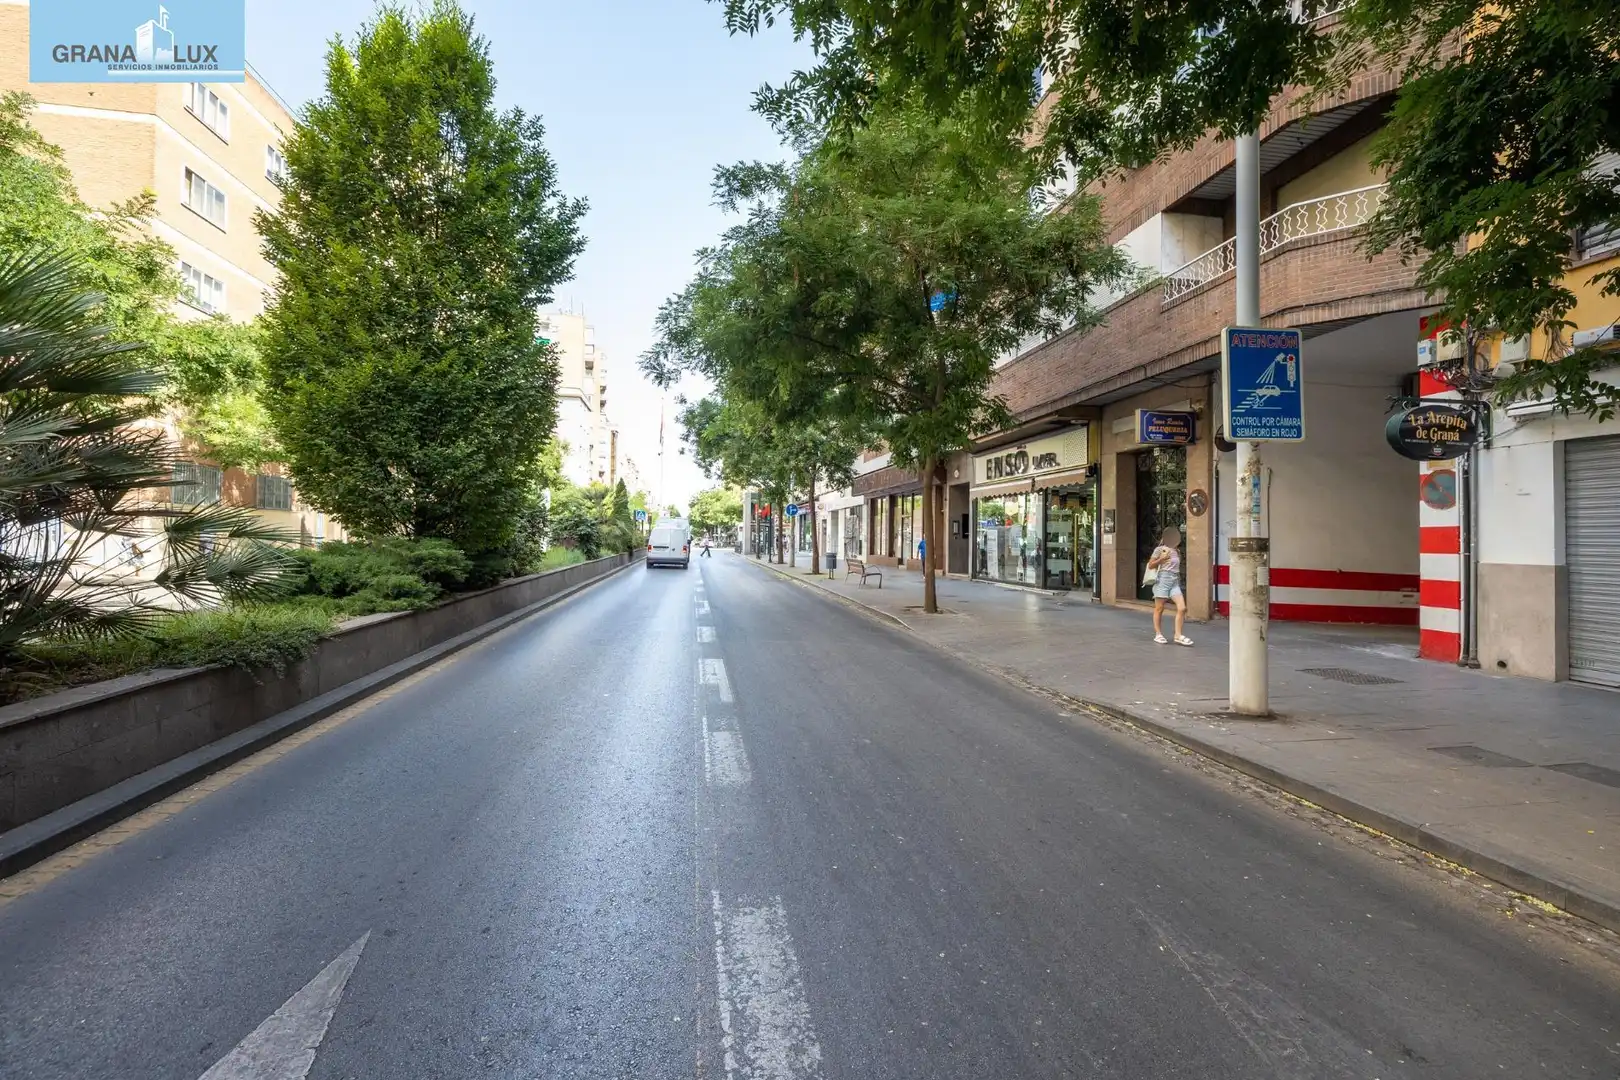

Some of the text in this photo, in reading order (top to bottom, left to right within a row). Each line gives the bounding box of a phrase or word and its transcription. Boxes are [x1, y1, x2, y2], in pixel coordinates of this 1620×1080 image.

[1231, 332, 1298, 349] ATENCIÓN
[1231, 415, 1301, 427] CONTROL POR CÁMARA
[1408, 410, 1467, 430] La Arepita
[1236, 425, 1298, 437] SEMÁFORO EN ROJO
[1415, 425, 1460, 443] de Graná
